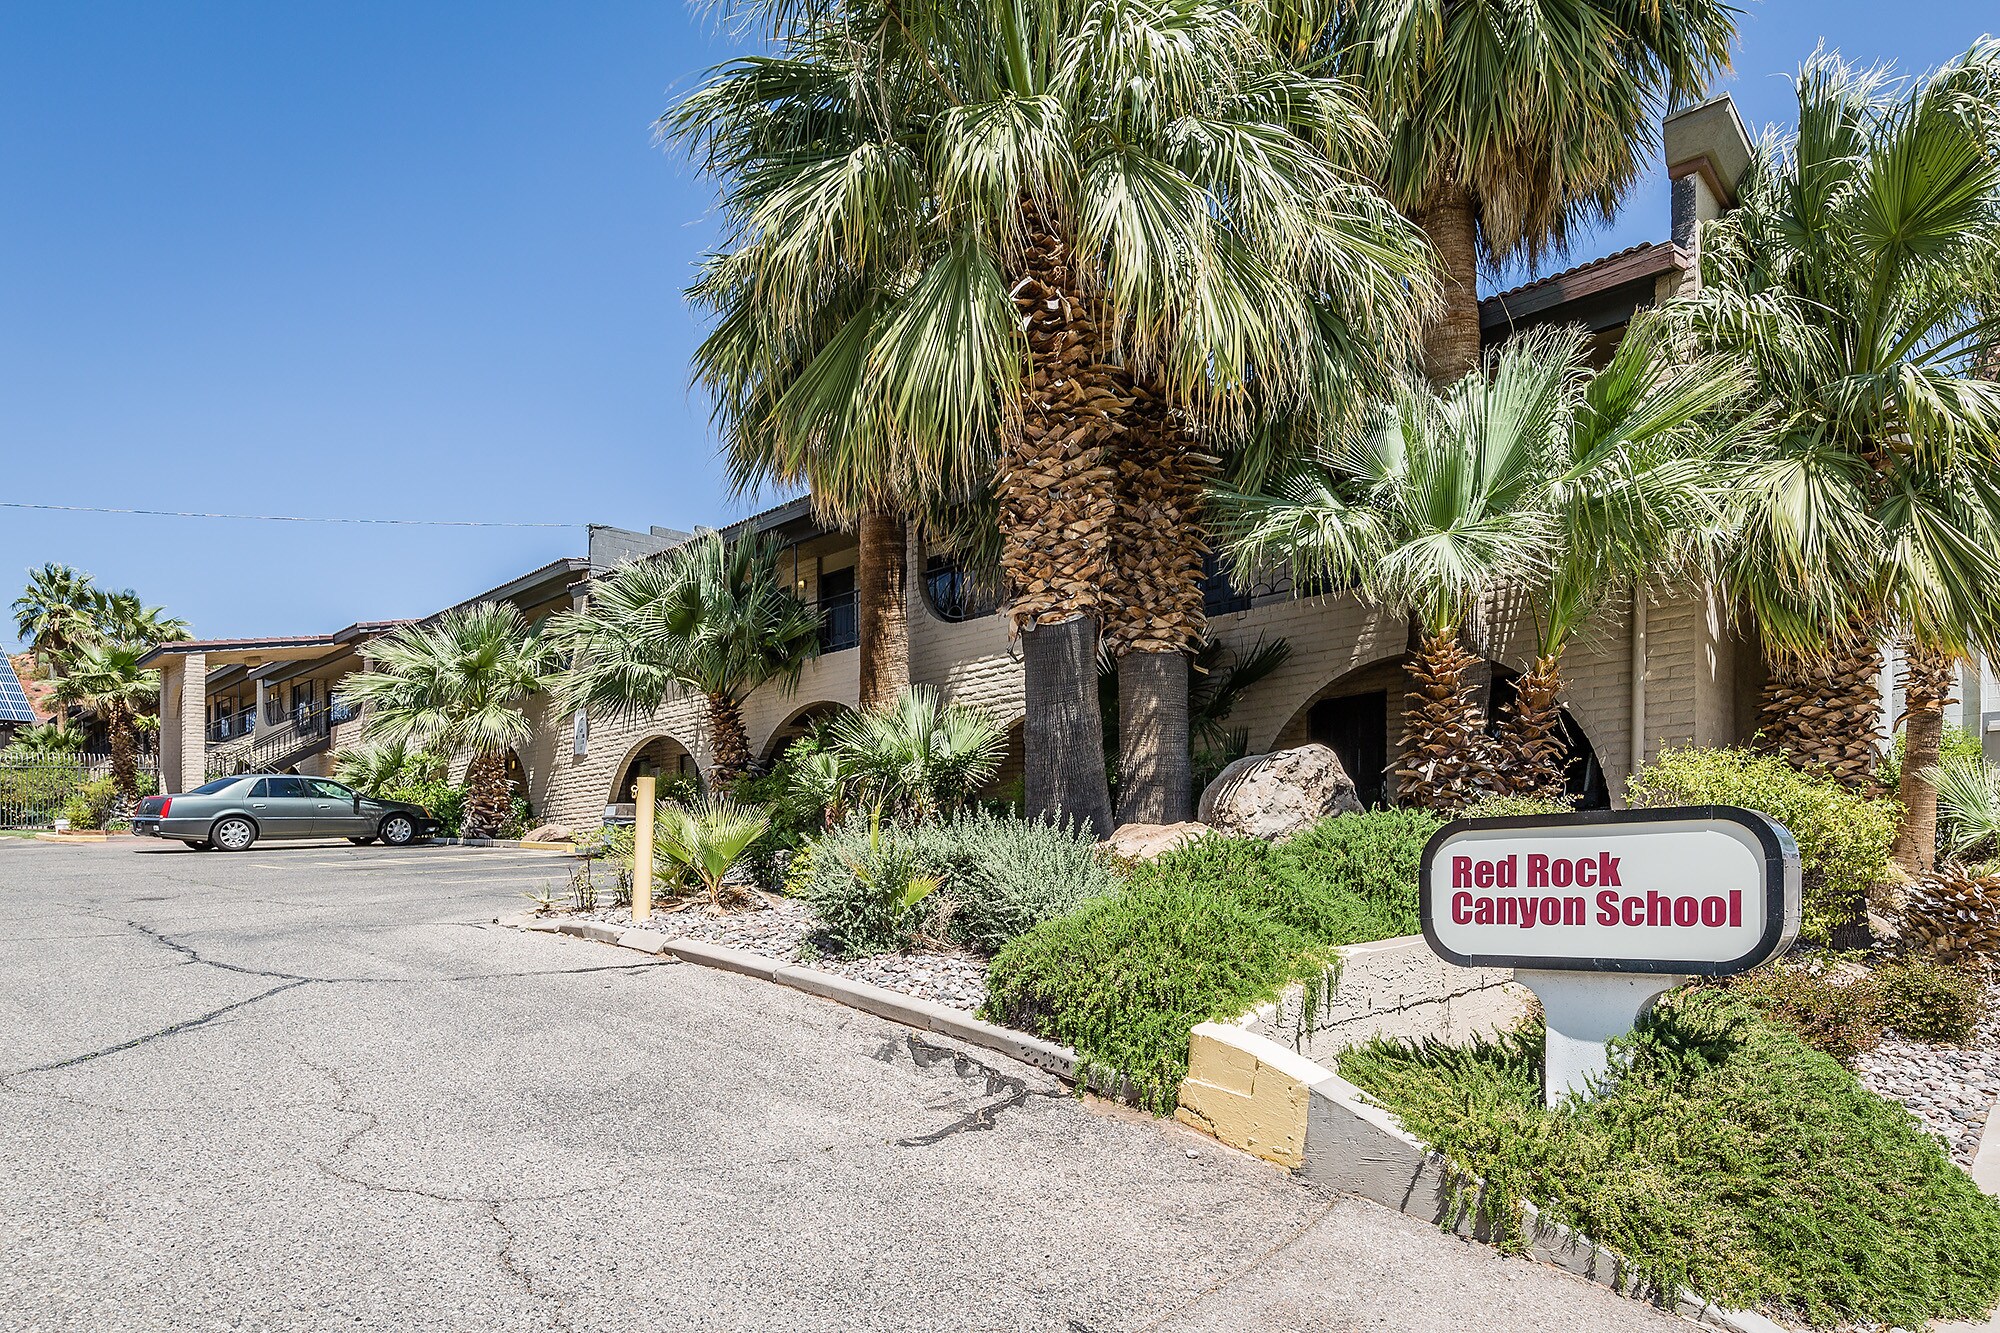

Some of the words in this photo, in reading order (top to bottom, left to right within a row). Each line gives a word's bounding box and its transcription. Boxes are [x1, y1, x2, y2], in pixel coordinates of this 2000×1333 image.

[1452, 853, 1517, 889] Red
[1527, 851, 1622, 888] Rock
[1451, 891, 1586, 929] Canyon
[1596, 889, 1742, 928] School
